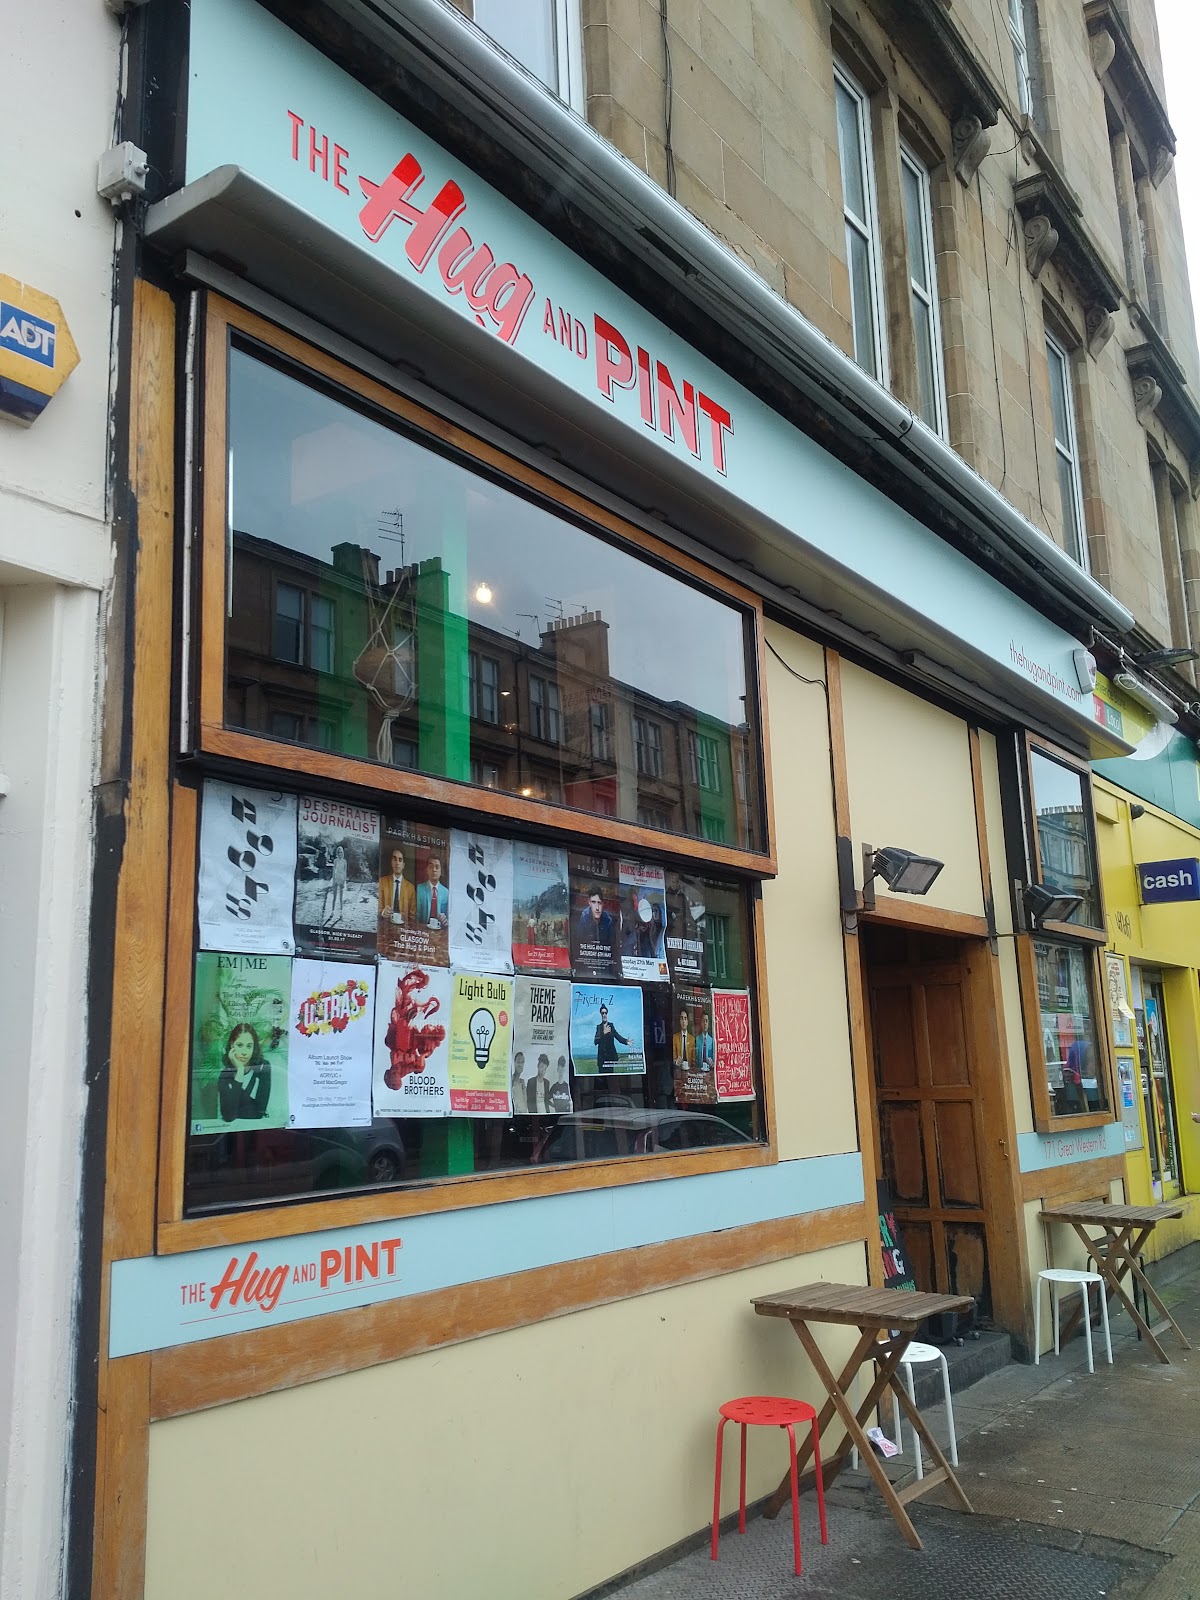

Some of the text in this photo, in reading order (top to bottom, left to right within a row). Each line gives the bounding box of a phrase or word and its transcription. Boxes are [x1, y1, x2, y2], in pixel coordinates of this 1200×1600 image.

[287, 109, 735, 478] THE Hug AND PINT
[0, 316, 55, 356] ADT
[1009, 638, 1082, 704] thehugandpint.com
[303, 798, 377, 823] DESPERATE
[302, 810, 377, 834] JOURNALIST
[422, 835, 446, 846] SINGH
[620, 863, 664, 880] BMX Bandits
[1143, 870, 1192, 889] cash
[400, 934, 430, 944] GLASGOW
[459, 978, 506, 1001] Light Bulb
[530, 986, 556, 1005] THEME
[530, 1004, 555, 1024] PARK
[404, 1085, 445, 1096] BROTHERS
[409, 1075, 436, 1086] BLOOD
[1043, 1133, 1107, 1160] 171 Great Western Rd
[181, 1238, 403, 1312] THE Hug AND PINT
